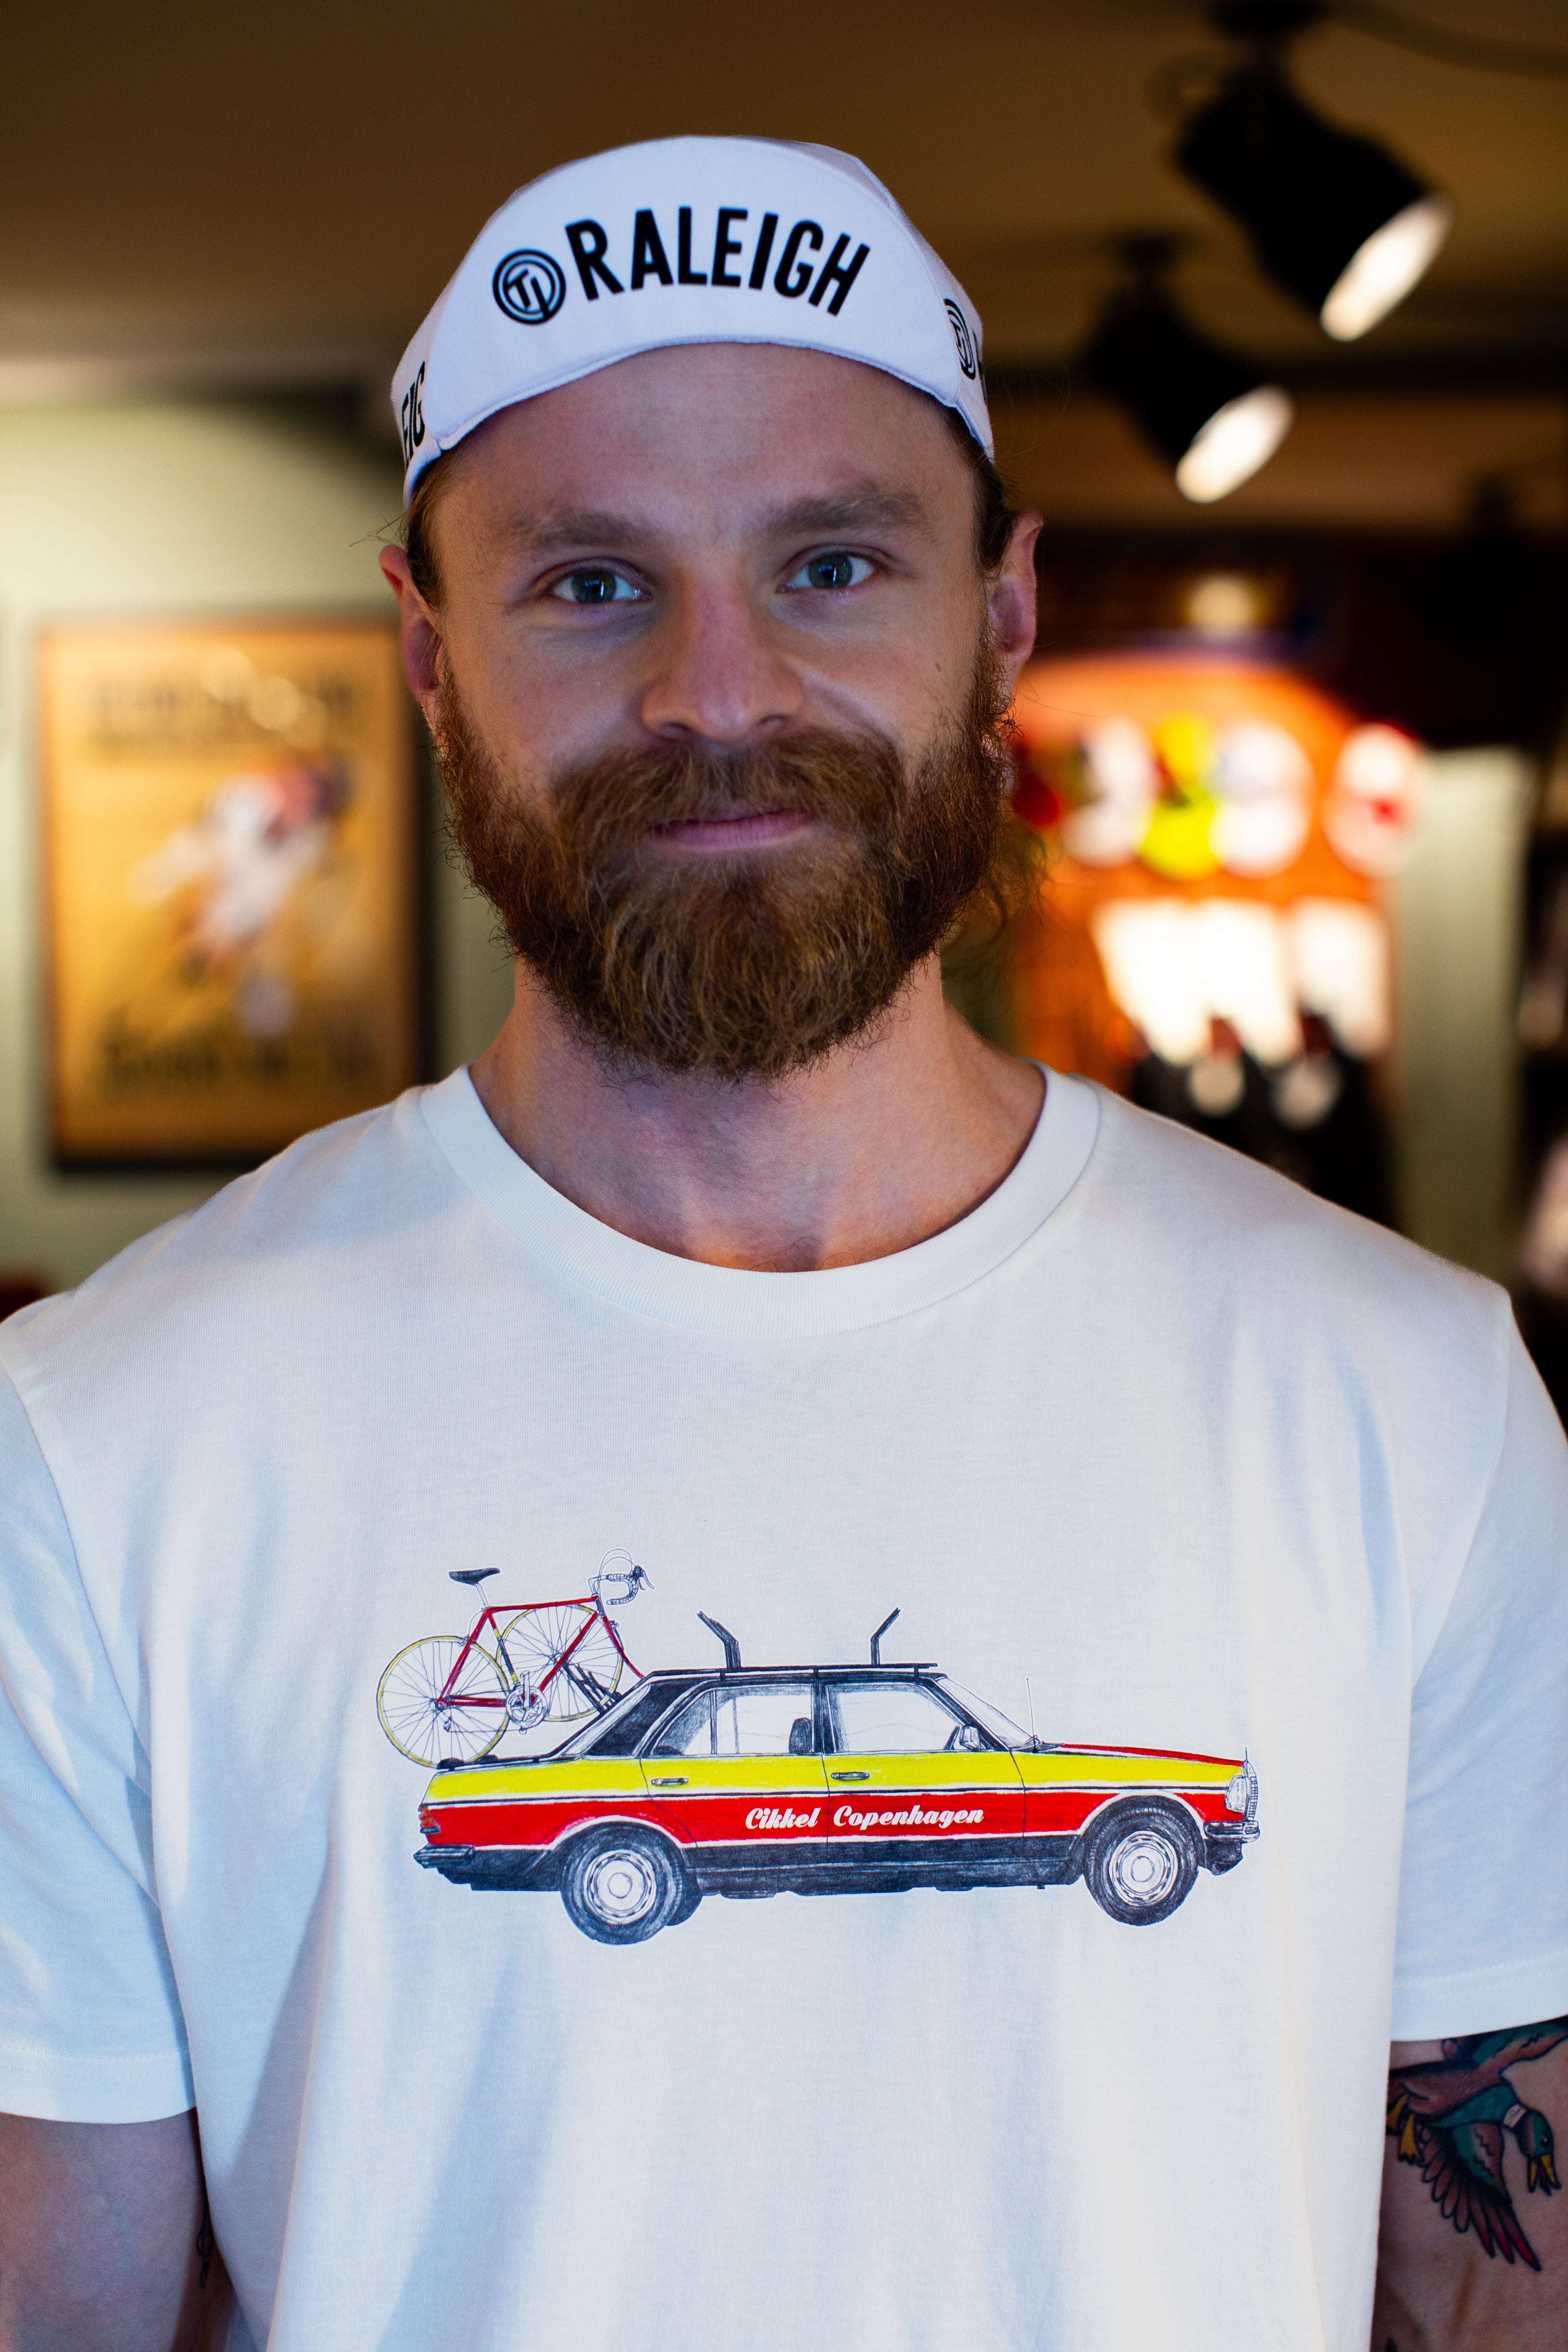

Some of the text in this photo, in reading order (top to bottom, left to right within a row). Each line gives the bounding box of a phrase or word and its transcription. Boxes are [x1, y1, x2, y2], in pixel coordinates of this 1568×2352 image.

[565, 206, 871, 316] RALEIGH
[745, 1804, 984, 1831] Cikkel Copenhagen
